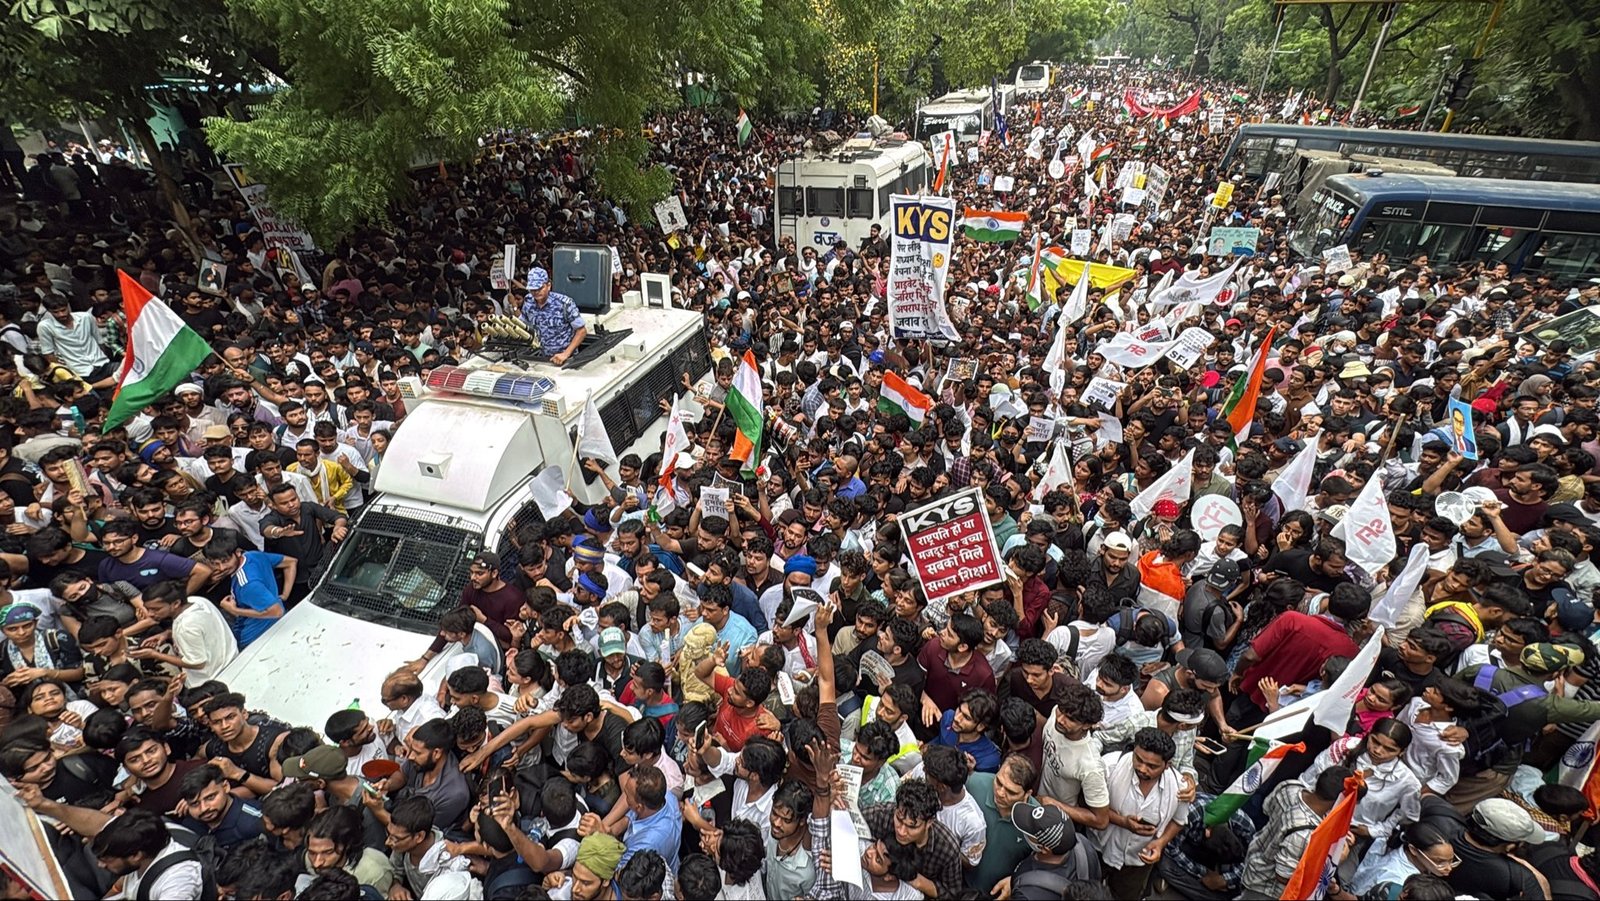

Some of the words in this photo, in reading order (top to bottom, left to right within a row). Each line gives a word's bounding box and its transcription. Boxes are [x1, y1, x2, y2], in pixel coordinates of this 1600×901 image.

[897, 206, 949, 240] KYS
[1382, 206, 1413, 216] SML
[896, 316, 920, 327] जवाब
[1169, 350, 1189, 366] SFI
[907, 497, 974, 533] KYS
[916, 527, 950, 546] राष्ट्रपति
[950, 523, 961, 537] हो
[962, 518, 975, 529] या
[916, 544, 945, 559] मजदूर
[945, 540, 960, 551] का
[960, 531, 983, 546] बच्चा
[925, 553, 958, 575] सबको
[959, 545, 984, 563] मिले
[925, 575, 958, 592] समान
